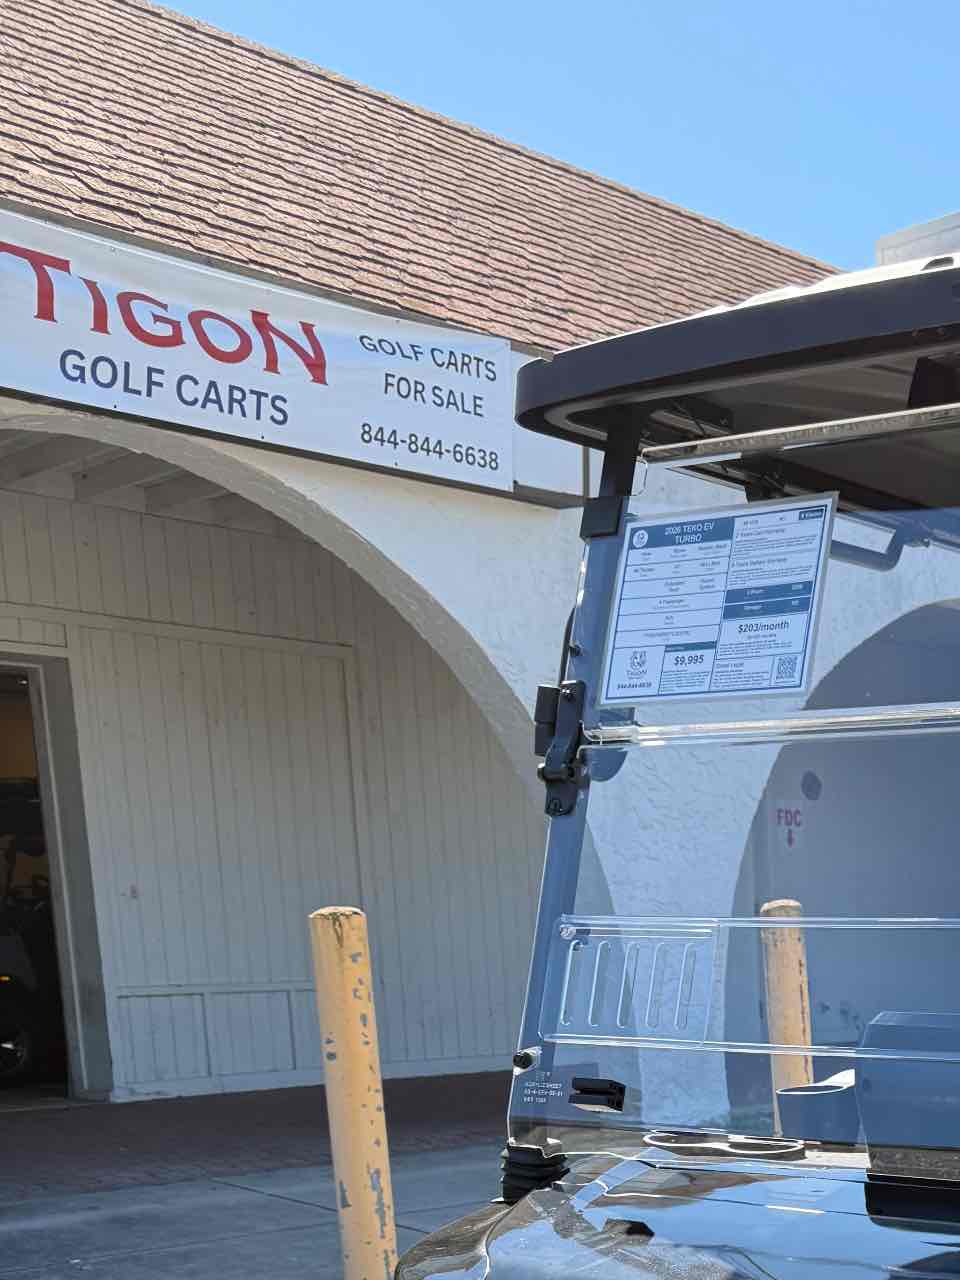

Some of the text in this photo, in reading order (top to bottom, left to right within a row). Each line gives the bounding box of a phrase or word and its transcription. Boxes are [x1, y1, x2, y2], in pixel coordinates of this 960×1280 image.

[0, 241, 328, 386] TIGON
[359, 334, 497, 382] GOLF CARTS
[59, 348, 290, 427] GOLF CARTS
[383, 372, 485, 418] FOR SALE
[360, 422, 499, 471] 844-844-6638
[674, 534, 703, 545] TURBO
[737, 620, 790, 633] $203/month
[673, 654, 705, 667] $9,995
[776, 808, 802, 827] FDC
